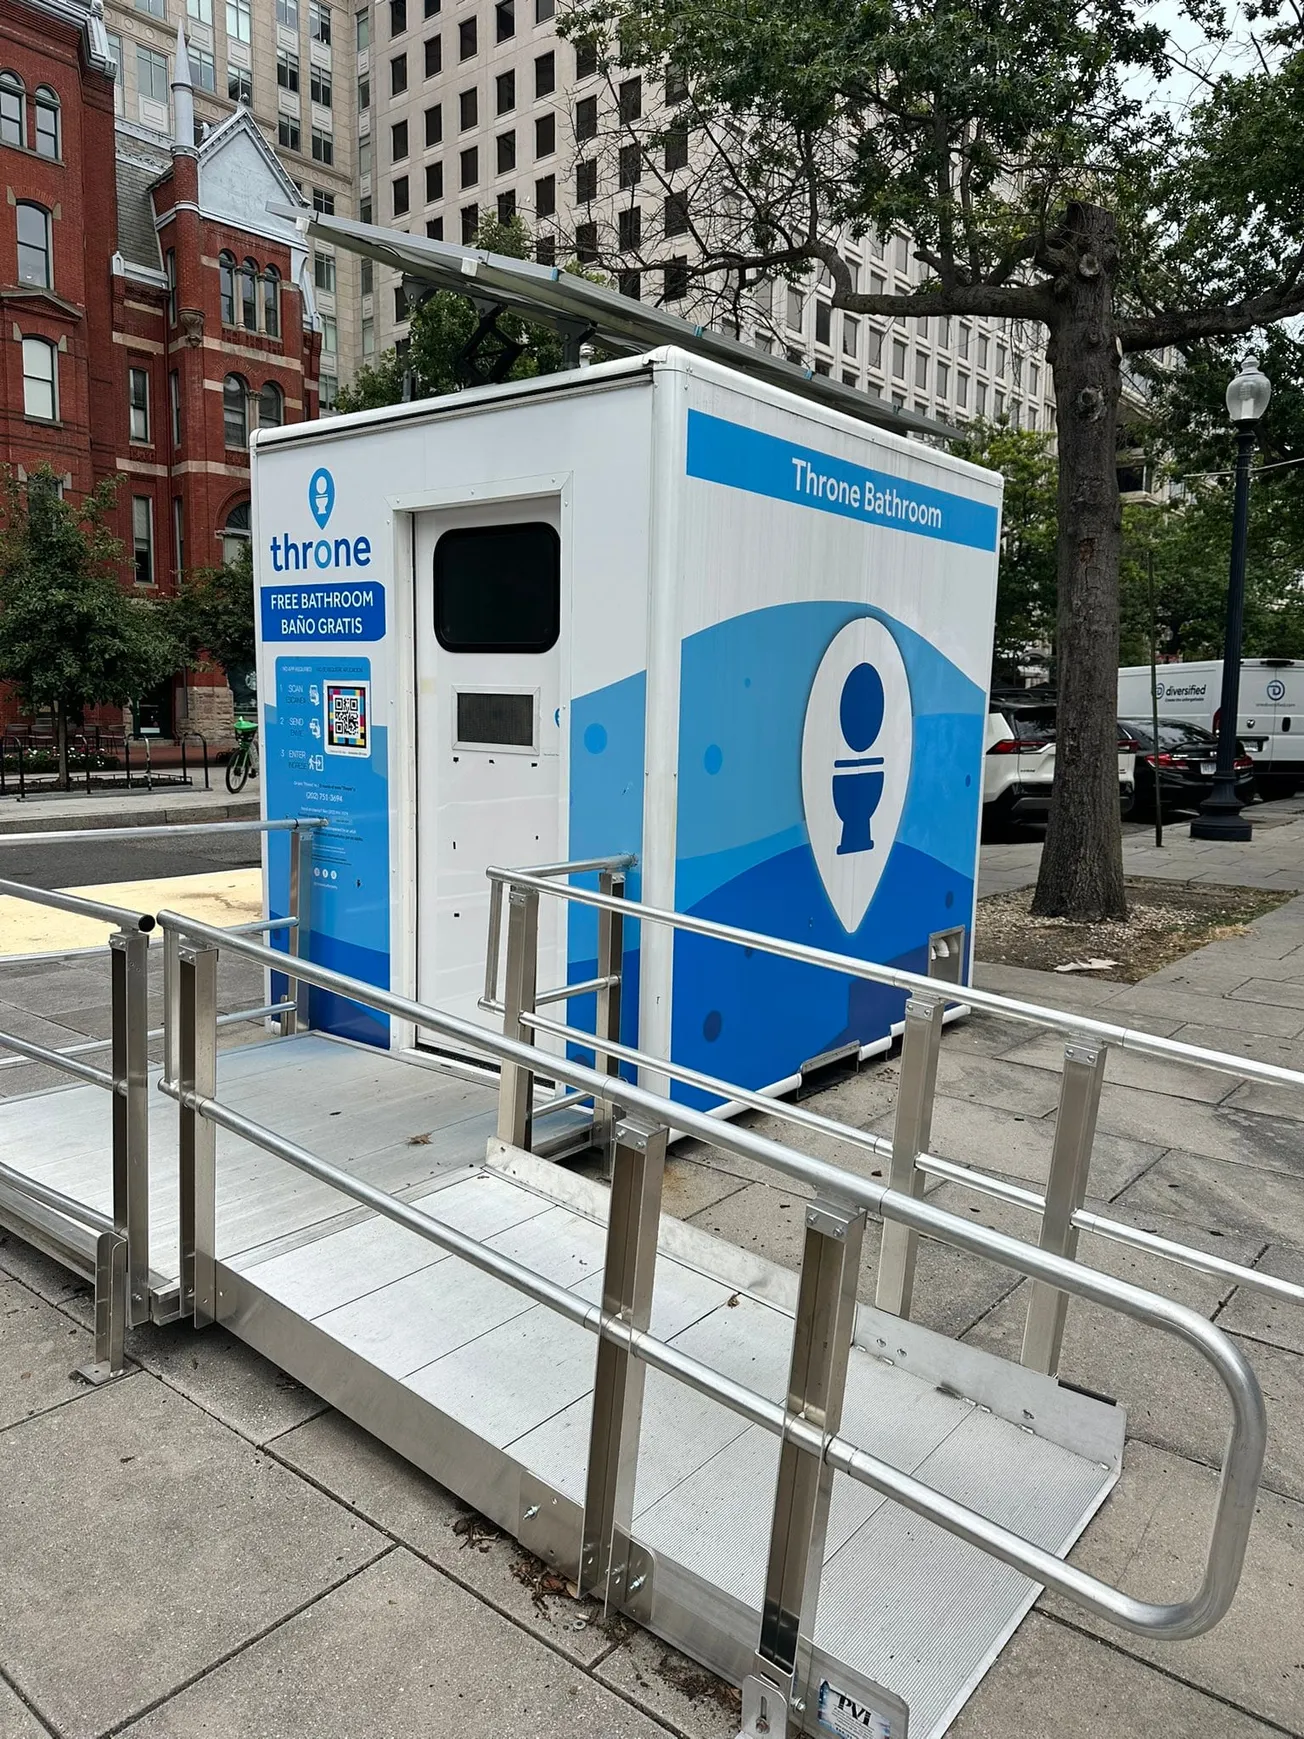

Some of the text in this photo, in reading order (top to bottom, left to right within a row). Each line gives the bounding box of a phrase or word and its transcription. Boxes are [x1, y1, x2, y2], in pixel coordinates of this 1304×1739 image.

[792, 457, 942, 528] Throne Bathroom
[270, 533, 371, 571] throne
[271, 591, 373, 609] FREE BATHROOM
[281, 615, 362, 634] BAÑO GRATIS
[288, 684, 304, 693] SCAN
[1166, 684, 1206, 696] diversified
[289, 717, 304, 726] SEND
[288, 750, 306, 759] ENTER
[838, 1695, 872, 1727] PVI
